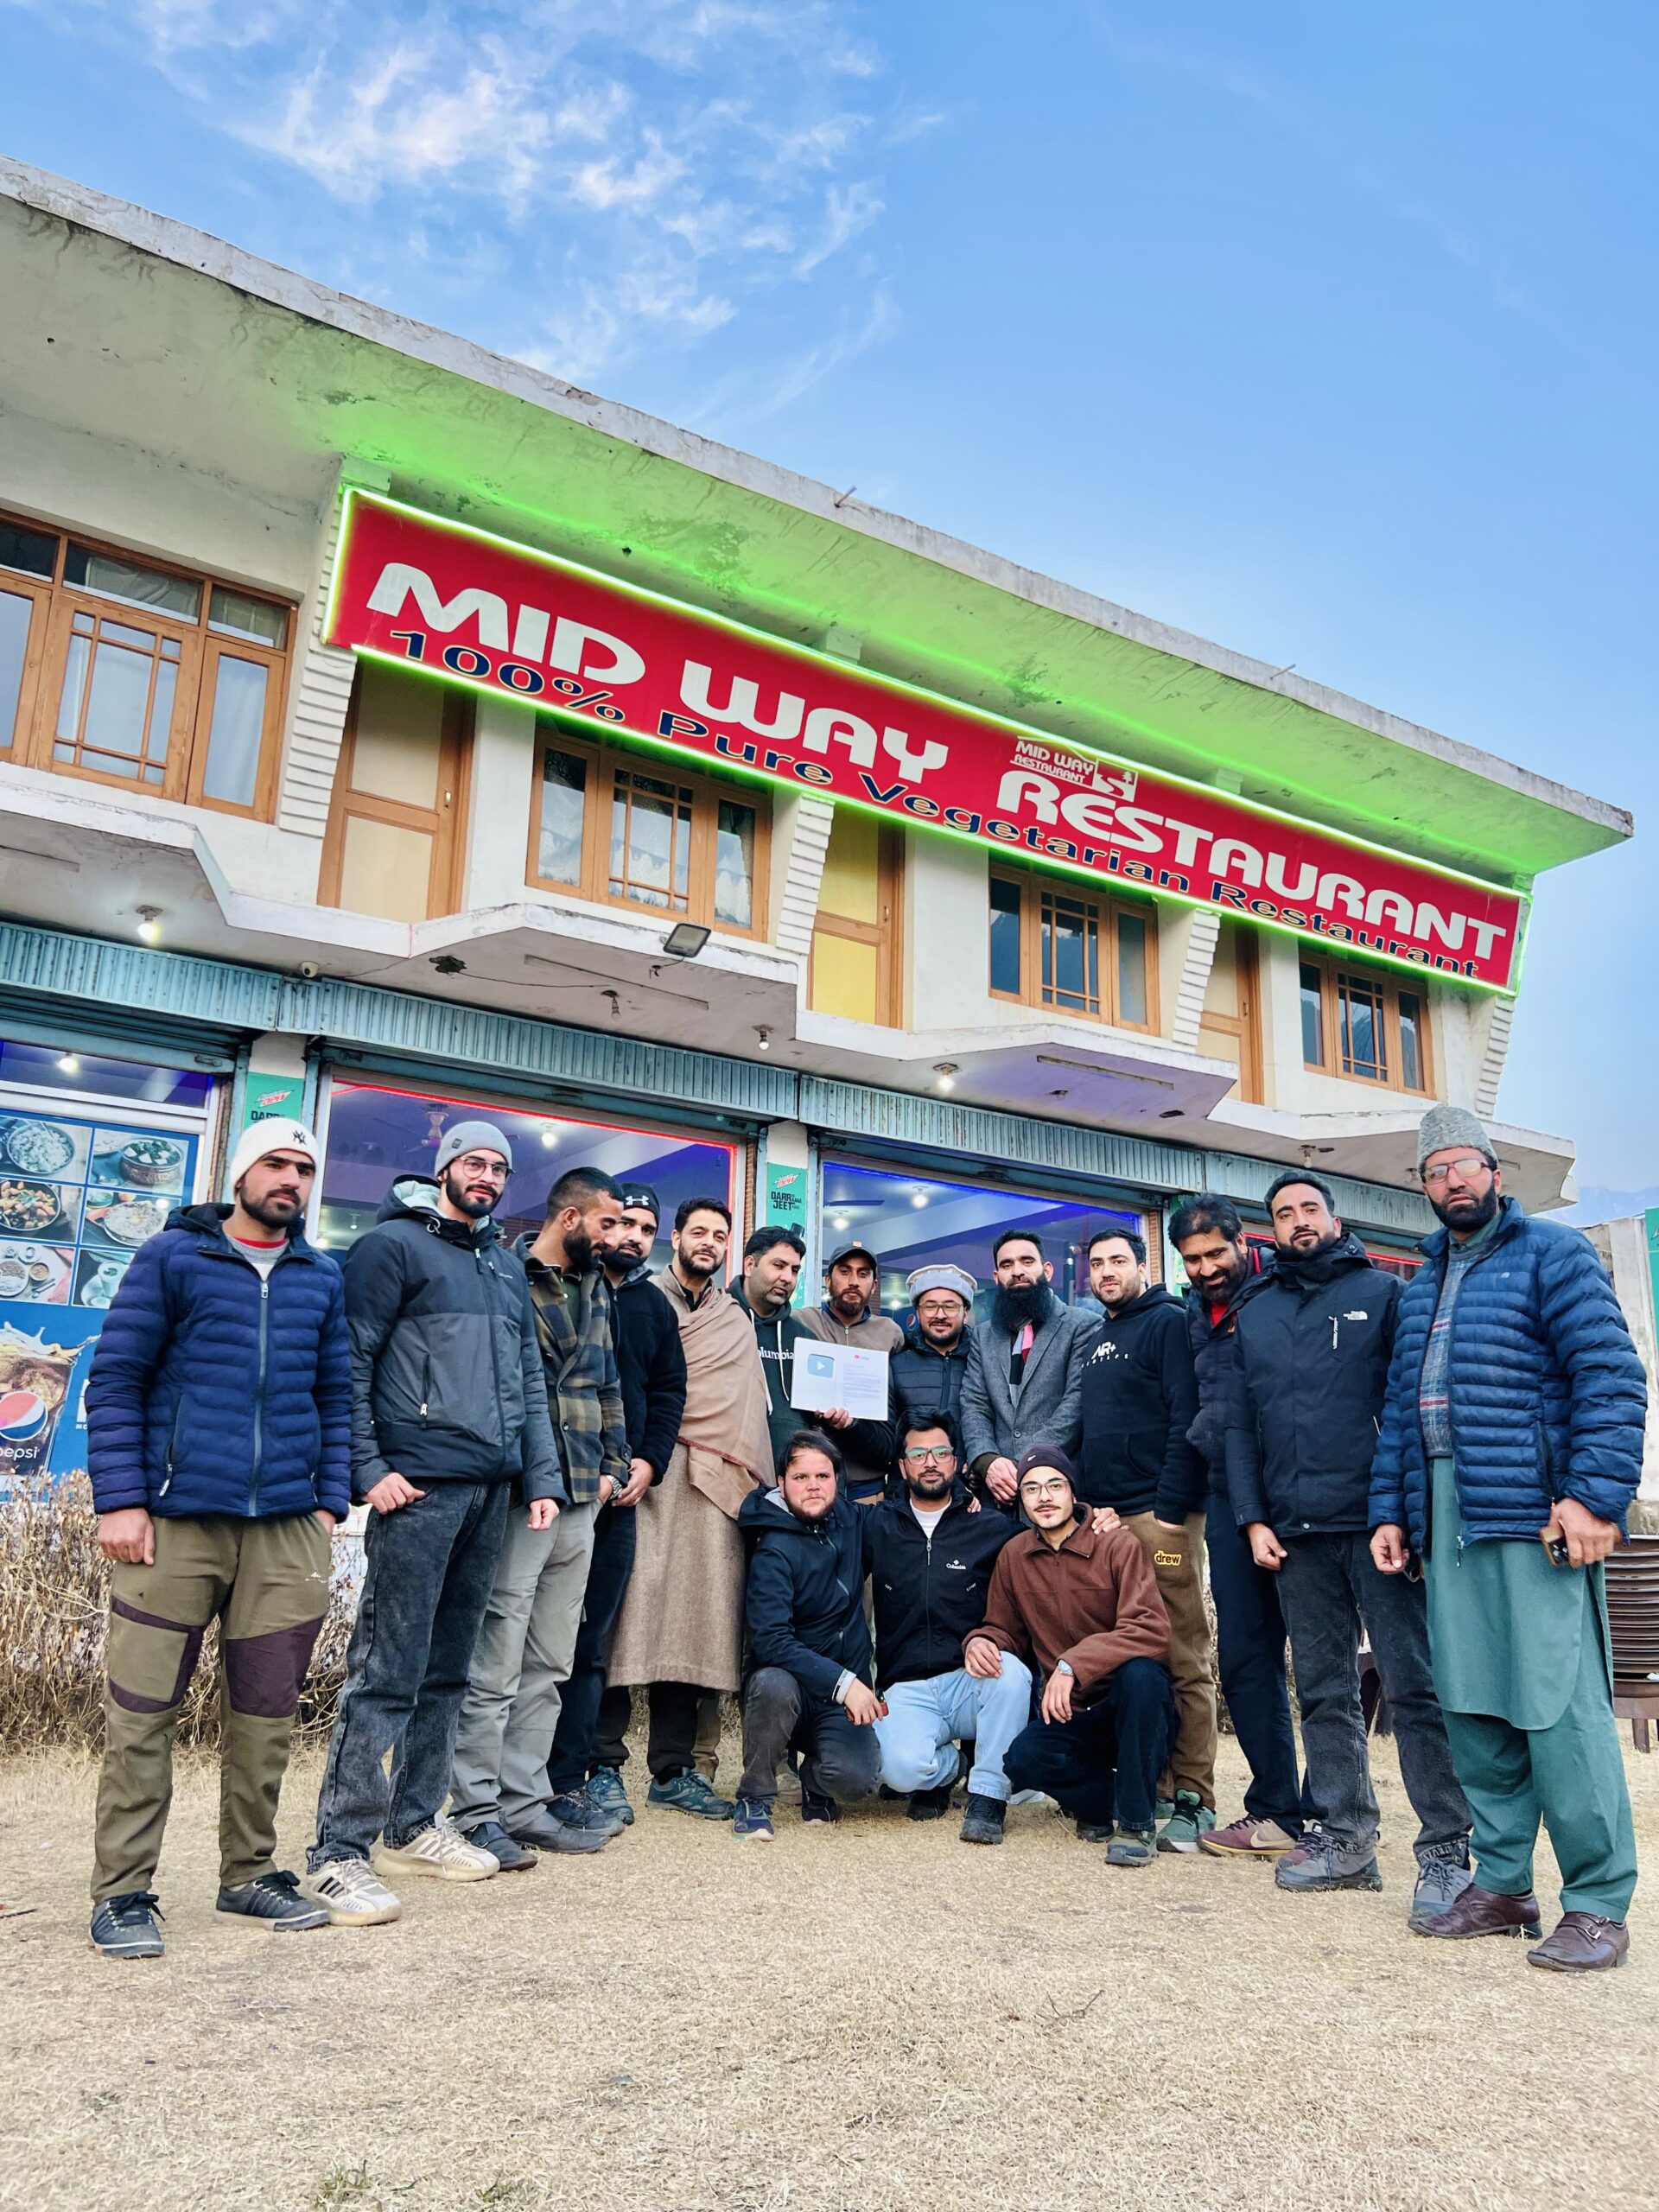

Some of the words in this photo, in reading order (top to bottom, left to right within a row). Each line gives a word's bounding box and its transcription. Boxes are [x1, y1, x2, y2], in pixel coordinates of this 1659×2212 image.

[366, 562, 646, 686] MID
[680, 659, 949, 785] WAY
[996, 770, 1508, 961] RESTAURANT
[1014, 753, 1086, 784] RESTAURANT
[1015, 741, 1051, 761] MID
[1053, 753, 1095, 776] WAY
[389, 629, 626, 725] 100%
[657, 709, 835, 786] Pure
[857, 772, 1191, 894] Vegetarian
[1210, 880, 1479, 980] Restaurant
[771, 1191, 791, 1202] DARR
[772, 1199, 796, 1211] JEET
[1155, 1551, 1180, 1565] drew
